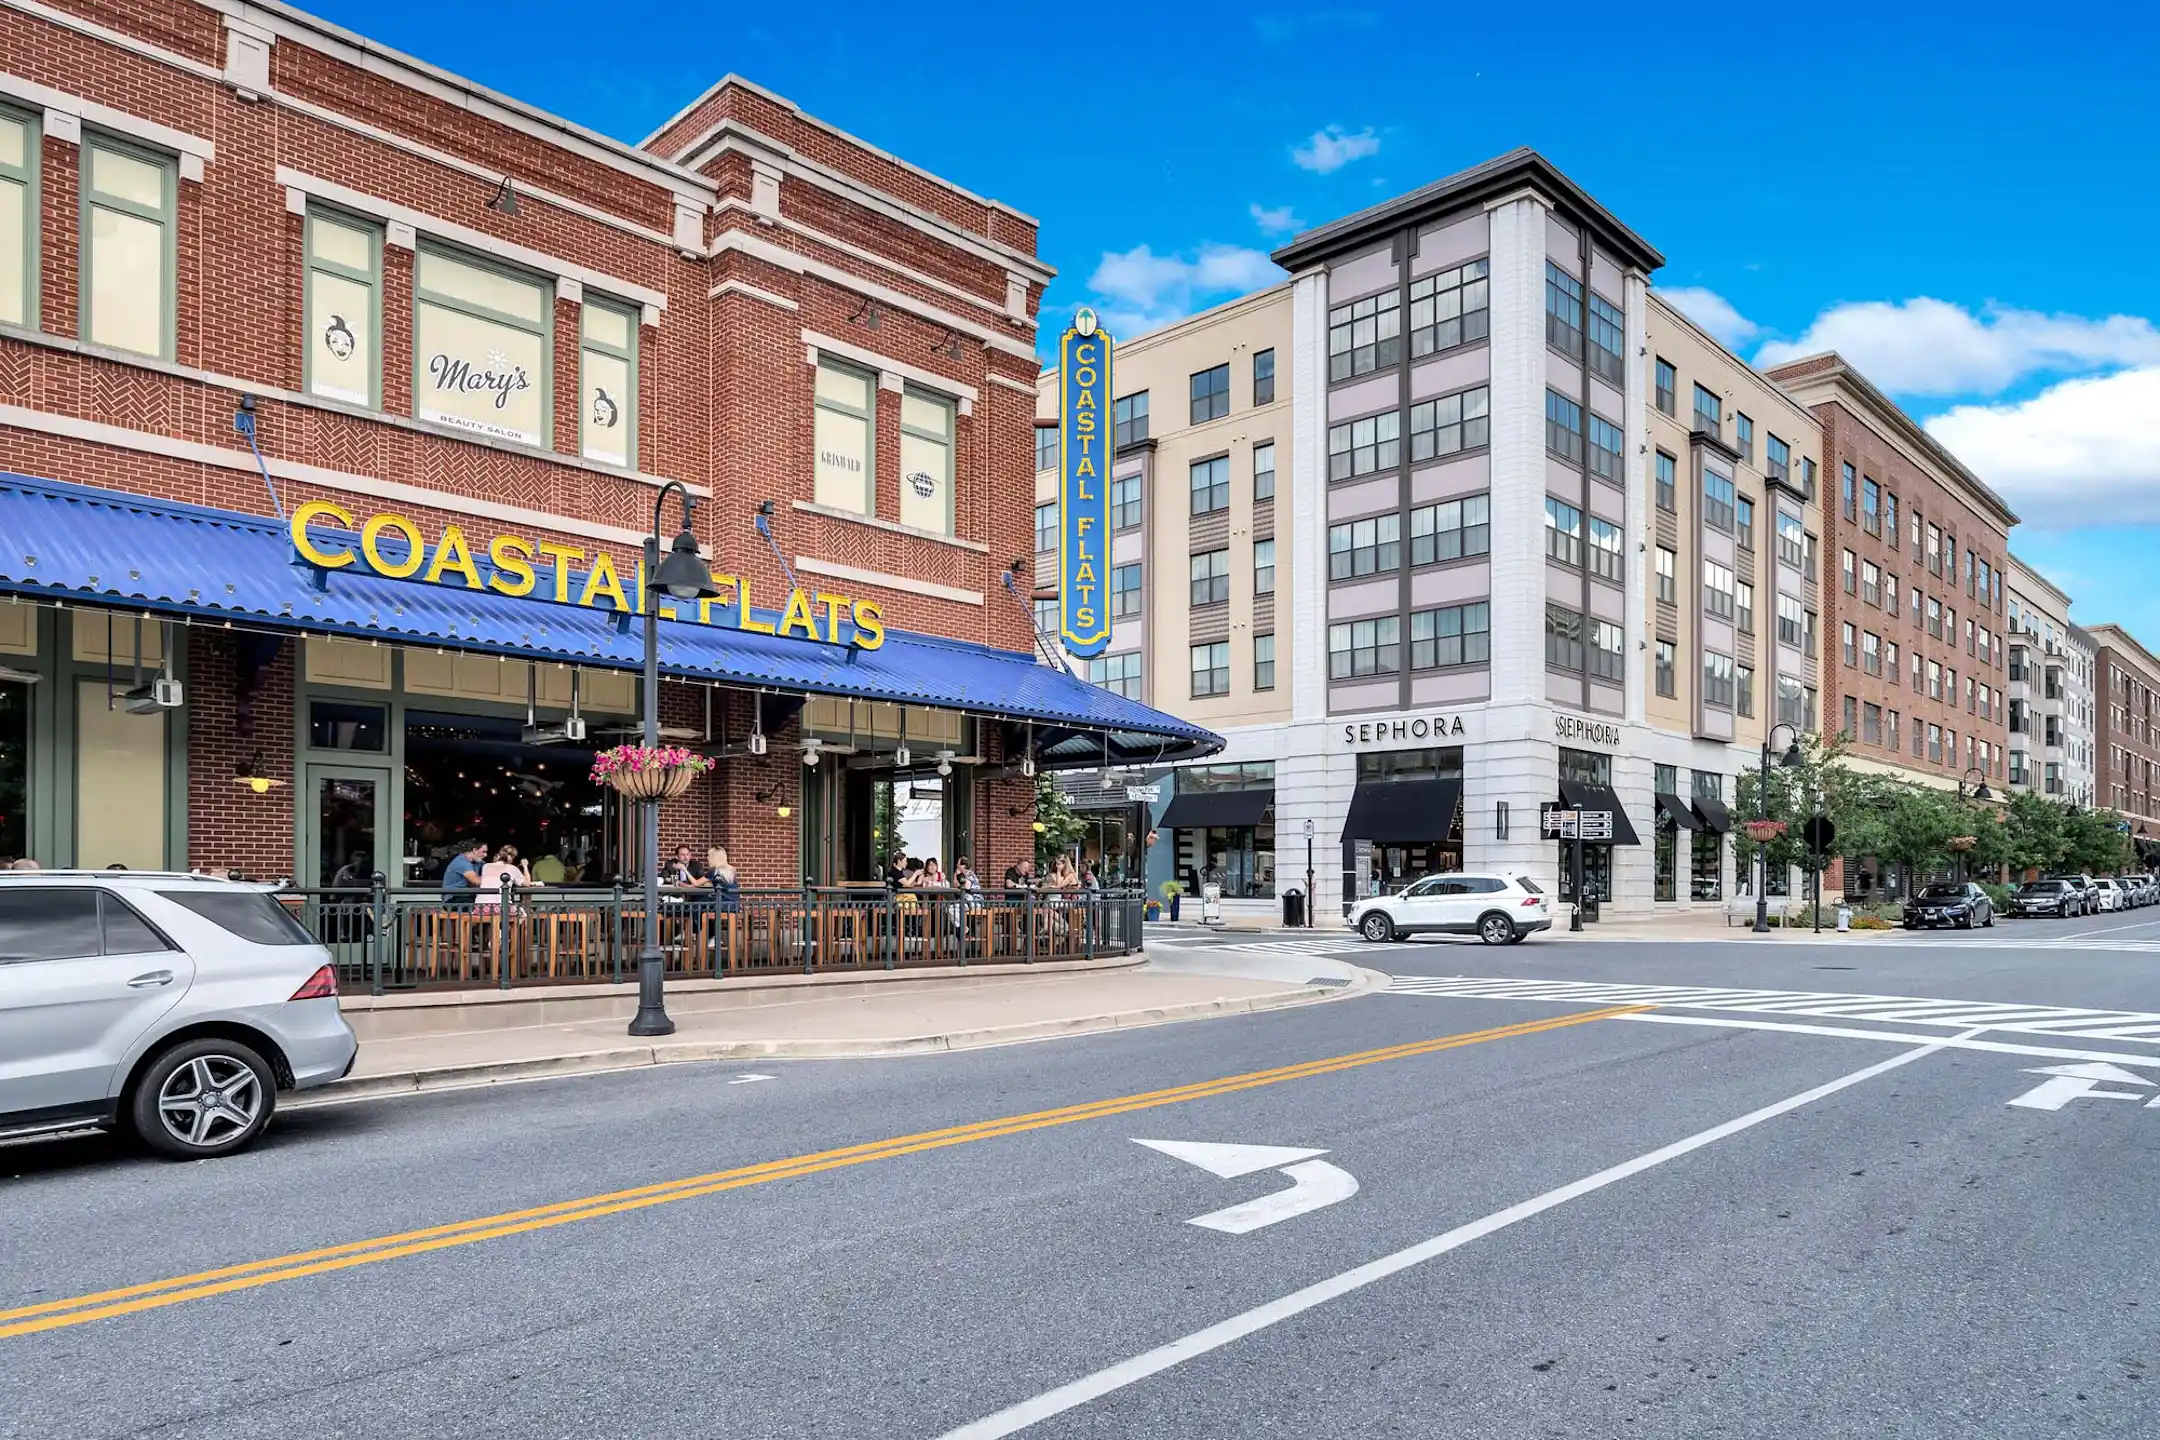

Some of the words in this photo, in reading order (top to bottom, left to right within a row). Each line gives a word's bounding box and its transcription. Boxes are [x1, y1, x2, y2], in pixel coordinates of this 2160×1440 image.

[429, 354, 531, 409] Mary's
[440, 415, 484, 430] BEAUTY
[487, 427, 522, 439] SALON
[1076, 344, 1096, 499] COASTAL
[1076, 517, 1096, 627] FLATS
[1345, 716, 1465, 743] SEPHORA
[1556, 716, 1621, 745] SEPHORA
